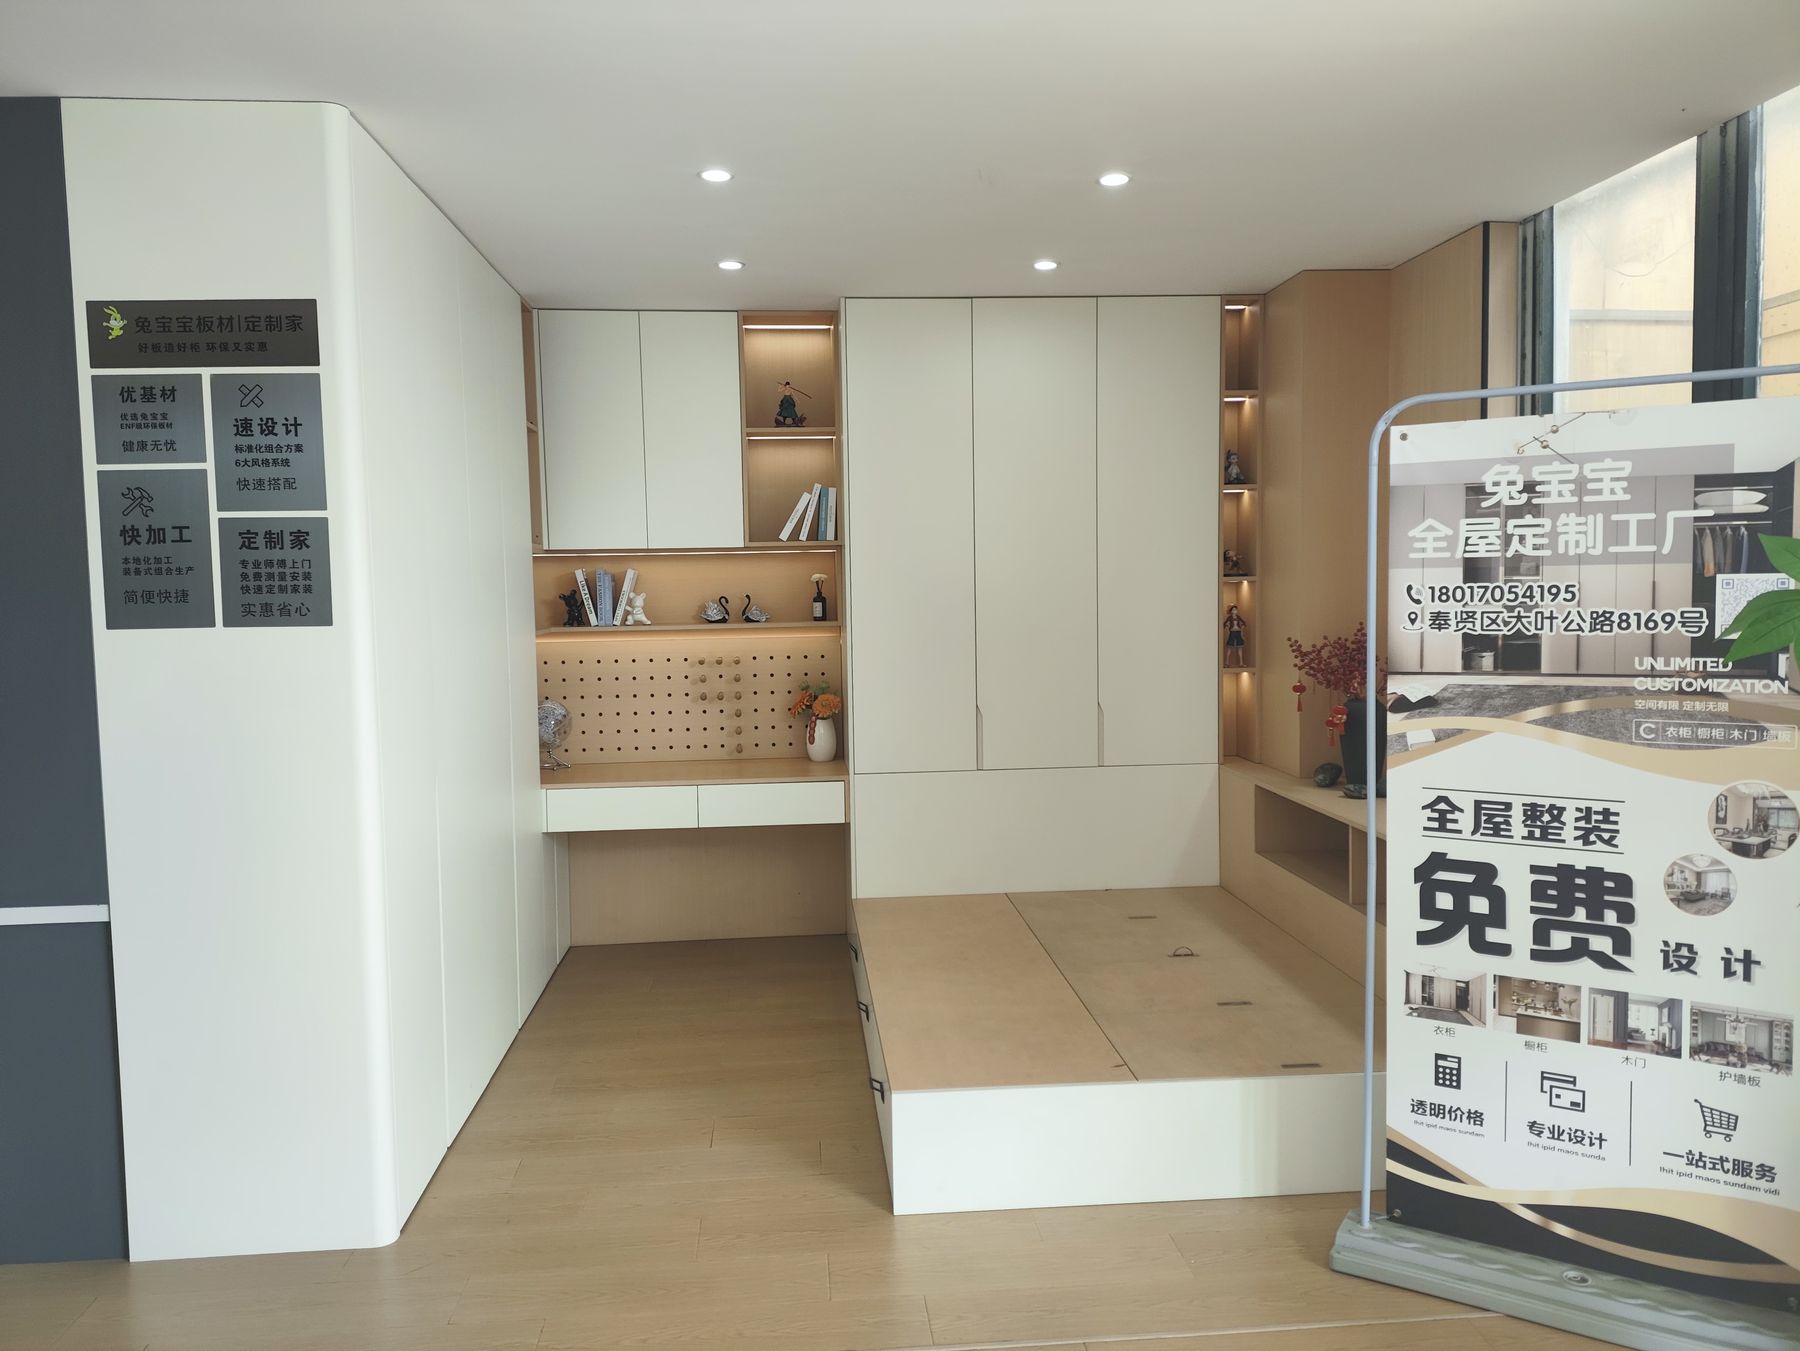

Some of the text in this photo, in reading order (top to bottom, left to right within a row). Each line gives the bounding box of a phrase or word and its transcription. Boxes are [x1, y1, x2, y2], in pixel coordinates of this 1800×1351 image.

[119, 385, 177, 403] 优基材
[233, 417, 303, 437] 速设计
[122, 439, 177, 452] 健康无忧
[234, 443, 304, 454] 标准化组合方案
[235, 458, 291, 468] 6大风格系统
[236, 477, 297, 491] 快速搭配
[1481, 458, 1633, 508] 兔宝宝
[120, 525, 193, 546] 快加工
[238, 529, 311, 550] 定制家
[1407, 509, 1715, 559] 全屋定制工厂
[122, 556, 173, 565] 本地化加工
[239, 559, 312, 569] 专业师傅上门
[122, 565, 195, 576] 装备式组合生产
[240, 571, 313, 582] 免费测量安装
[123, 588, 190, 604] 简便快捷
[240, 584, 313, 594] 快速定制家装
[1428, 584, 1578, 605] 18017054195
[241, 602, 311, 618] 实惠省心
[1427, 609, 1707, 635] 奉贤区大叶公路8169号
[1634, 657, 1733, 672] UNLIMITED
[1633, 677, 1789, 694] CUSTOMIZATION
[1634, 700, 1729, 712] 空间有限 定制无限
[1421, 795, 1621, 848] 全屋整装
[1414, 851, 1637, 973] 免费
[1659, 939, 1762, 983] 设计
[1433, 1025, 1456, 1038] 衣柜
[1524, 1040, 1548, 1053] 橱柜
[1621, 1055, 1647, 1069] 木门
[1719, 1070, 1762, 1088] 护墙板
[1410, 1098, 1485, 1127] 透明价格
[1526, 1120, 1608, 1150] 专业设计
[1557, 1148, 1579, 1156] maos
[1662, 1149, 1777, 1183] 一站式服务
[1676, 1169, 1693, 1179] ipid
[1695, 1175, 1721, 1184] maos
[1723, 1179, 1761, 1192] sundam
[1763, 1186, 1781, 1196] vidi
